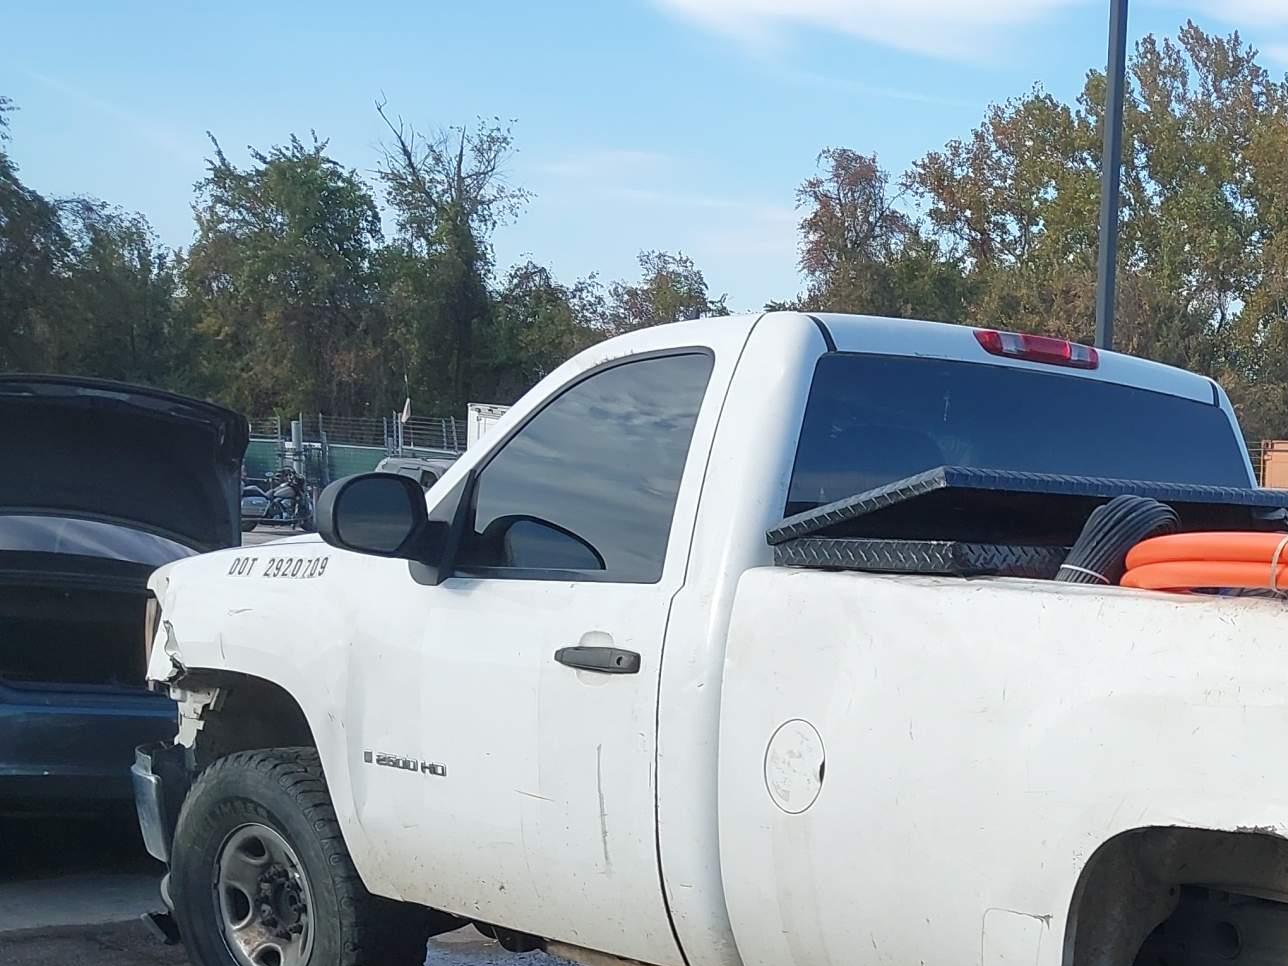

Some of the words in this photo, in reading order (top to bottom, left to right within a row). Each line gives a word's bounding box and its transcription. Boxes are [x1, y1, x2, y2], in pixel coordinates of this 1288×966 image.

[228, 557, 258, 576] DOT
[263, 556, 329, 578] 2920709
[375, 752, 419, 772] 2500
[420, 761, 447, 777] HD
